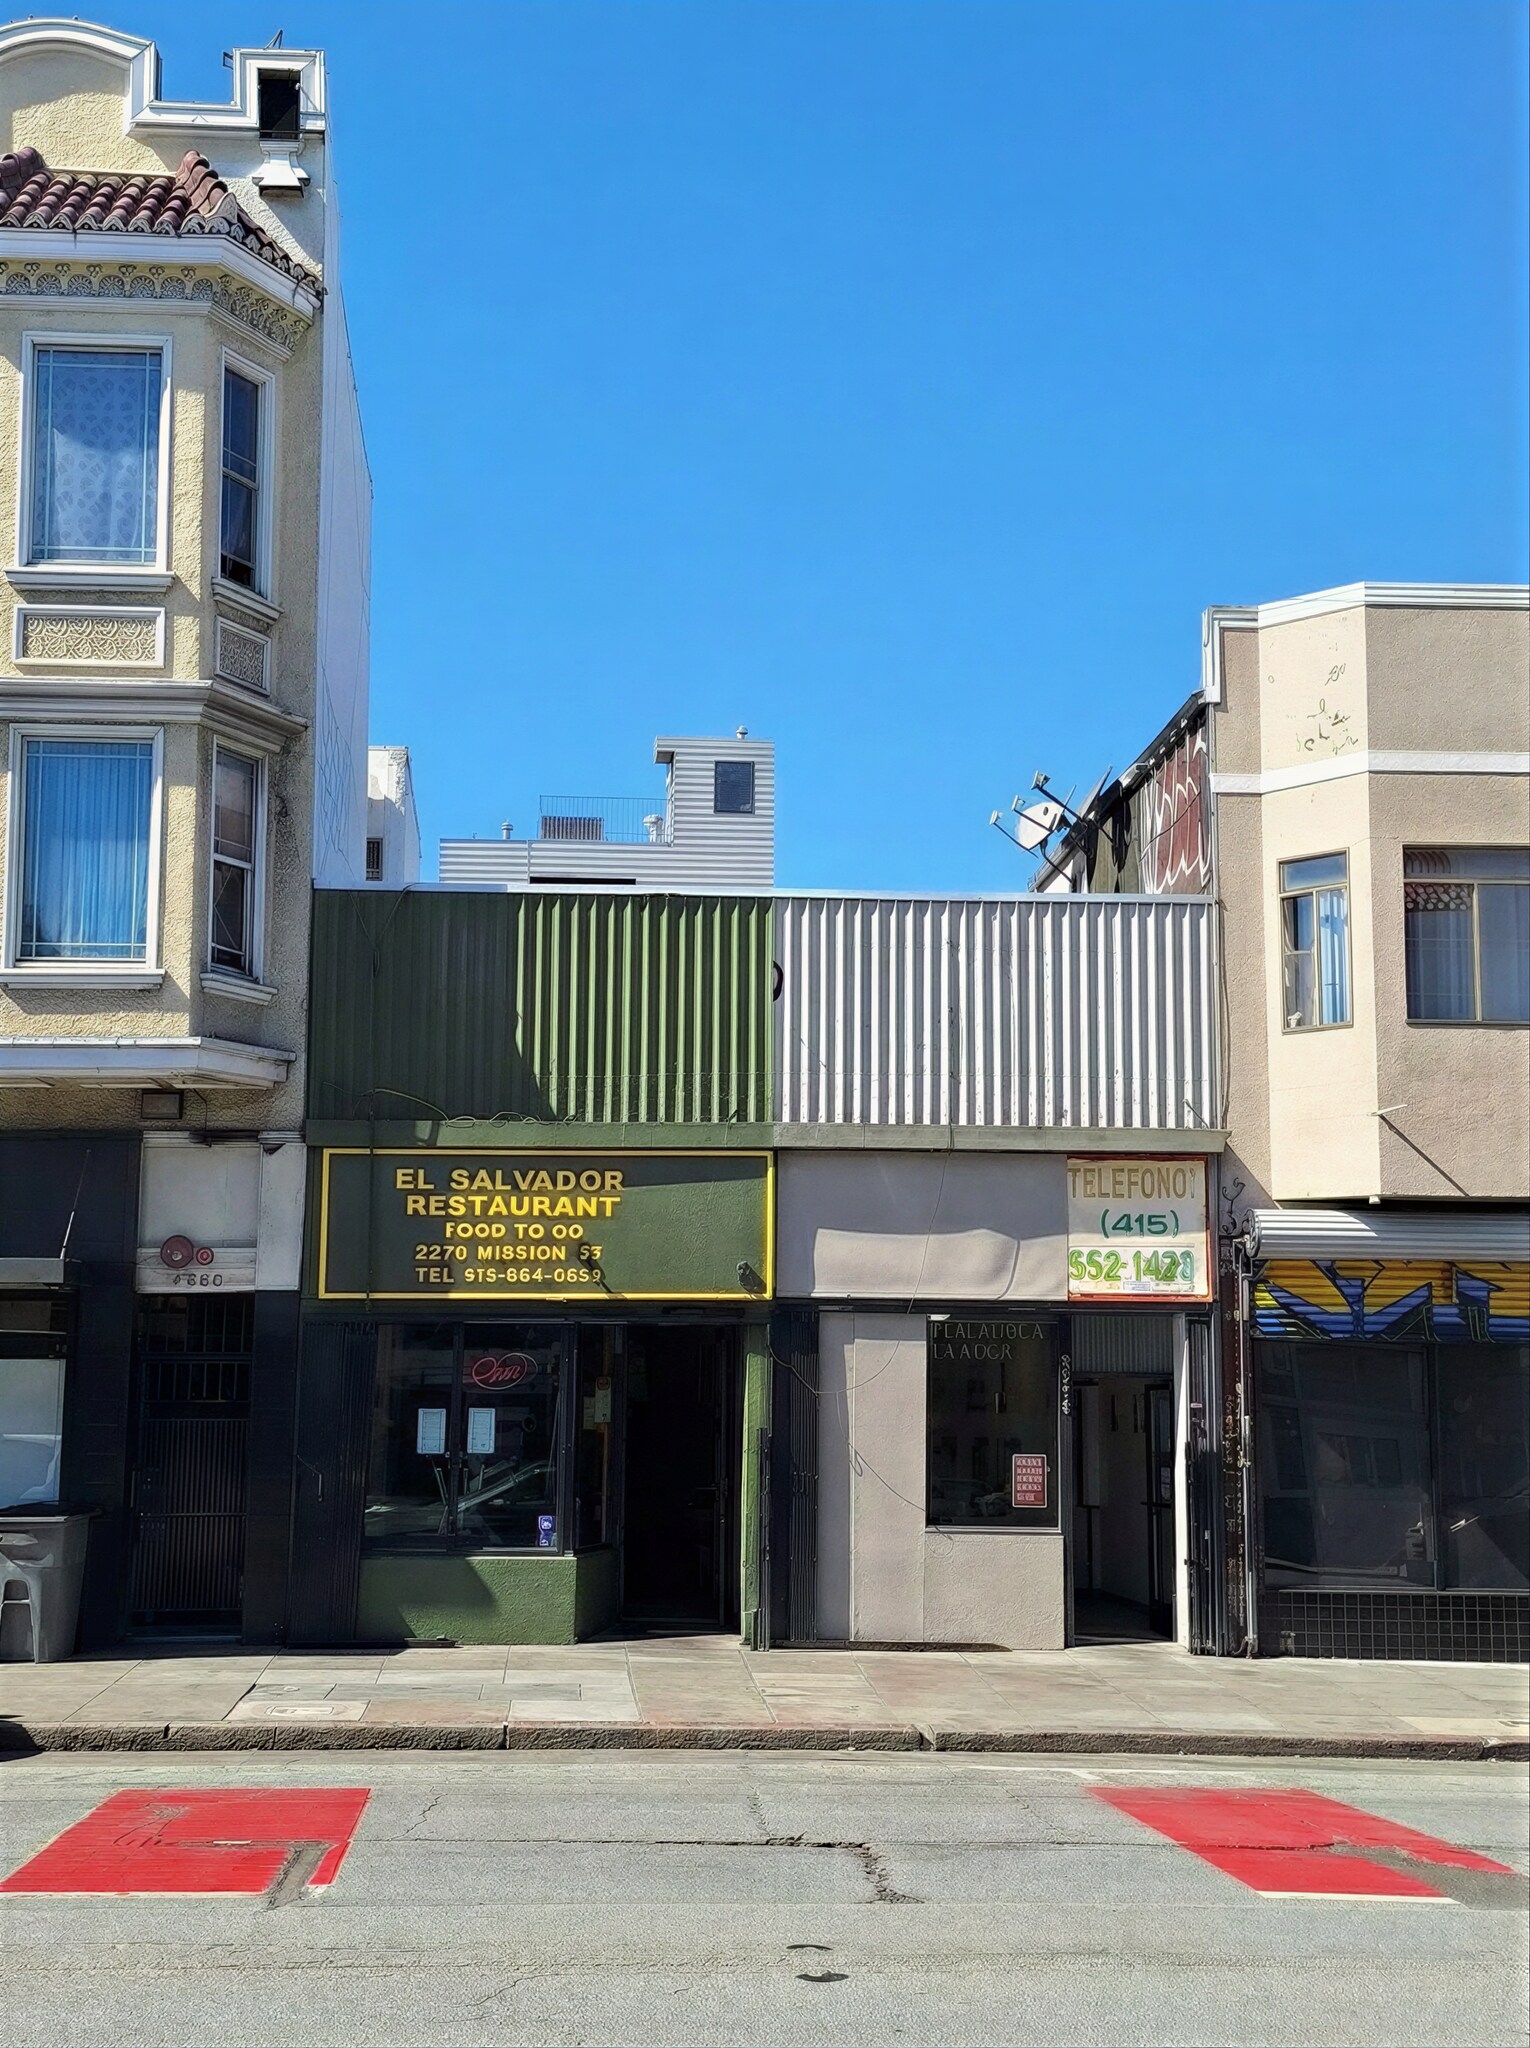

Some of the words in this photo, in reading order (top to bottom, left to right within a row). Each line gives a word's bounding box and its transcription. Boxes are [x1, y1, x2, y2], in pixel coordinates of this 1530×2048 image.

[396, 1169, 434, 1190] EL
[450, 1169, 624, 1192] SALVADOR
[406, 1195, 621, 1217] RESTAURANT
[445, 1222, 506, 1239] FOOD
[514, 1223, 545, 1239] TO
[1101, 1208, 1179, 1239] (415)
[415, 1245, 467, 1260] 2270
[477, 1245, 566, 1261] MISSION
[415, 1267, 455, 1283] TEL
